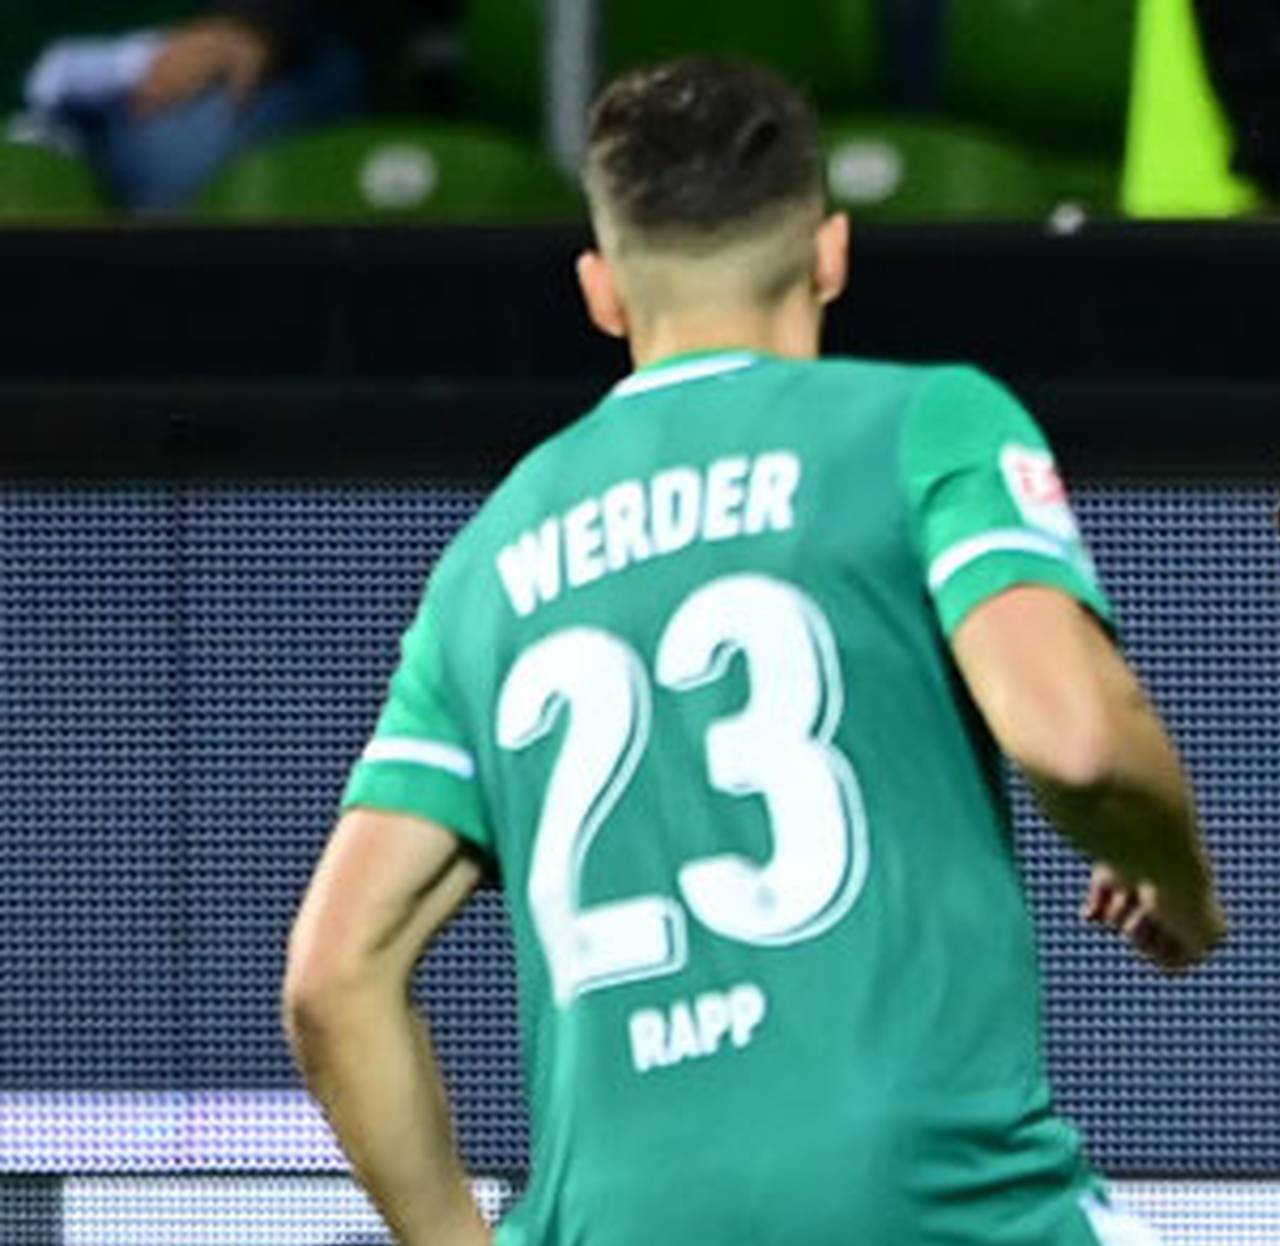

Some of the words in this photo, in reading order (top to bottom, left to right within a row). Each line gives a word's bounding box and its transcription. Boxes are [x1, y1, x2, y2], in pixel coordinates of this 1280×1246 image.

[495, 450, 800, 616] WERDER
[495, 571, 871, 1010] 23
[629, 984, 767, 1073] RAPP
